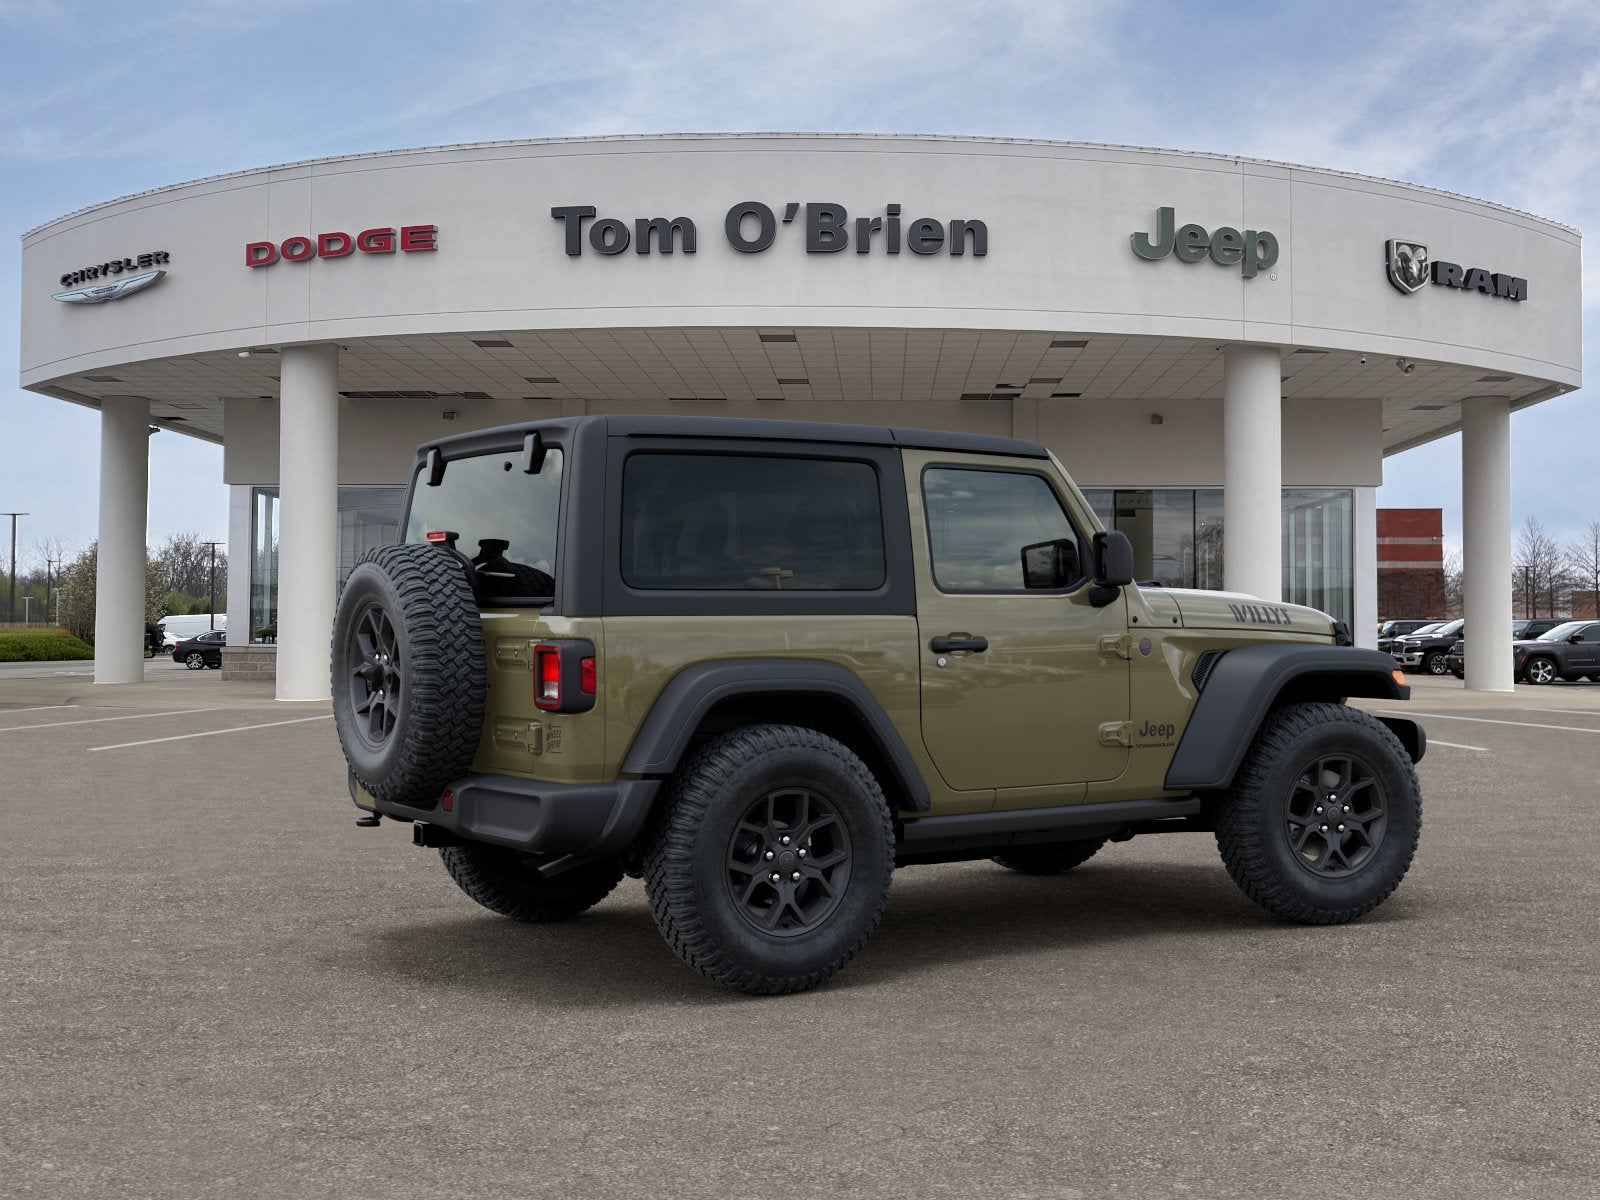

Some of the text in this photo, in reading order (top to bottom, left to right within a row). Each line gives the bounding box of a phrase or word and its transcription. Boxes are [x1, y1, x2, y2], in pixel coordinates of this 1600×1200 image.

[245, 224, 439, 269] DODGE
[550, 200, 989, 257] Tom O'Brien
[1130, 206, 1280, 279] Jeep
[60, 250, 170, 287] CHRYSLER
[1430, 260, 1529, 302] RAM
[1227, 603, 1292, 625] WILLYS
[1138, 720, 1175, 740] Jeep
